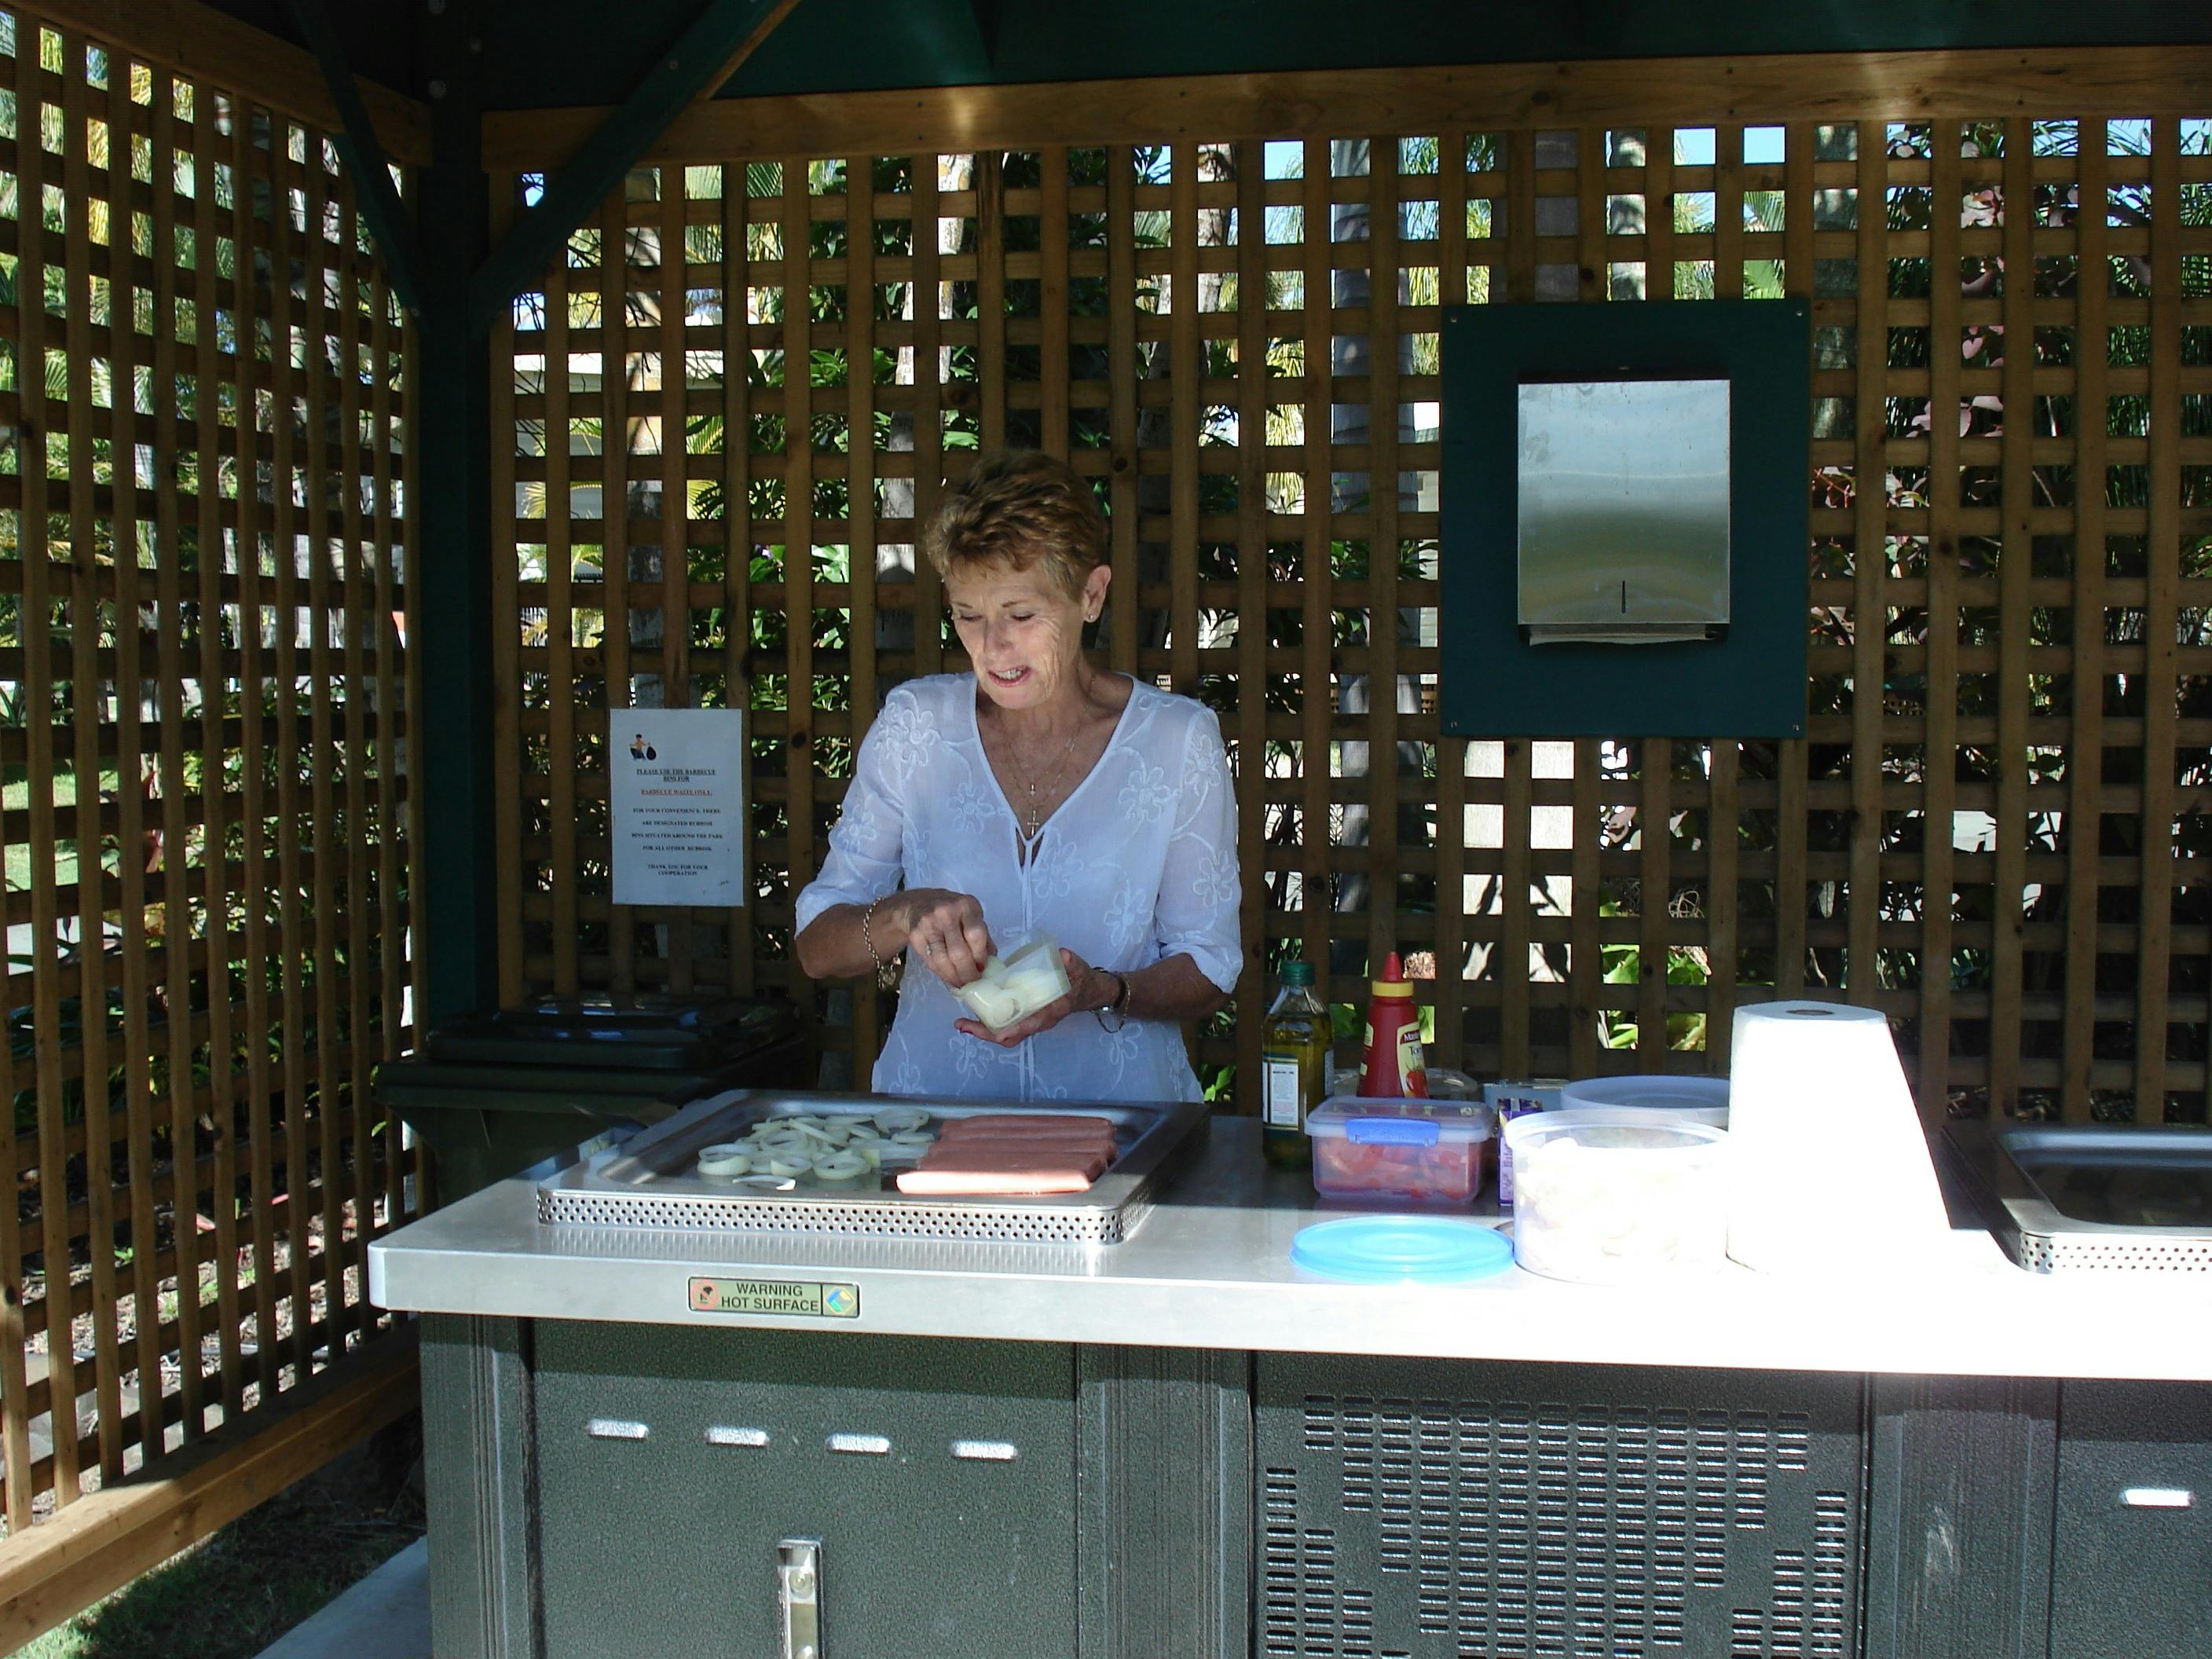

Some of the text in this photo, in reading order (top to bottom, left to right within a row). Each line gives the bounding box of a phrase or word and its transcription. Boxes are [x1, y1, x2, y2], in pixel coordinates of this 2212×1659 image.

[737, 1283, 803, 1296] WARNING
[721, 1297, 819, 1312] HOT SURFACE
